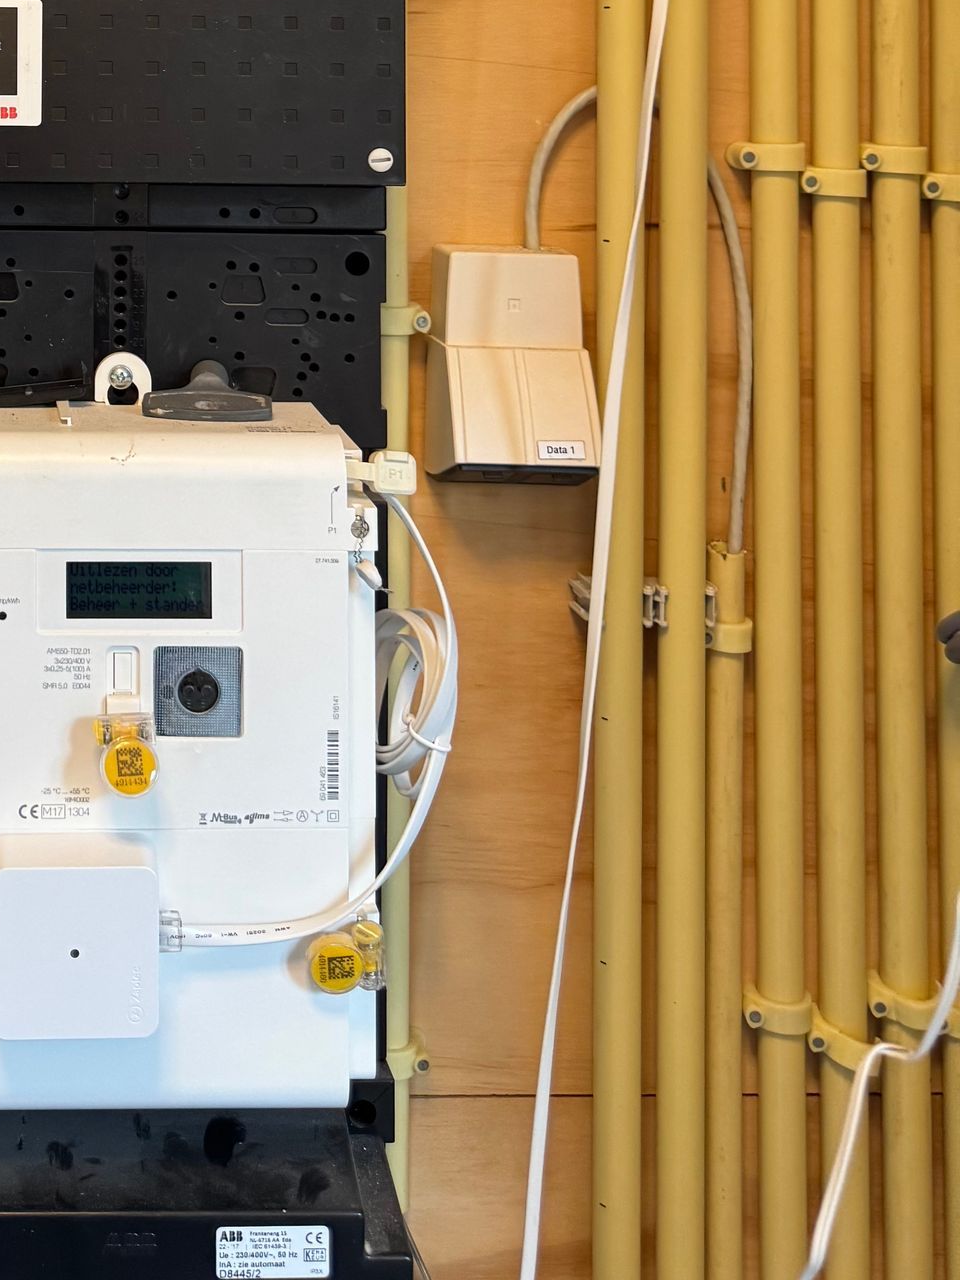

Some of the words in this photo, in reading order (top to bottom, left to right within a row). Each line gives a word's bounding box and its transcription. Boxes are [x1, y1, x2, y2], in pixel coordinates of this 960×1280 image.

[546, 445, 567, 454] Data
[570, 445, 575, 454] 1
[328, 527, 337, 535] P1
[69, 563, 138, 577] Uitlezen
[145, 563, 178, 577] door
[69, 580, 177, 595] netbeheerder:
[69, 597, 120, 611] Beheer
[42, 806, 63, 816] M17
[68, 806, 90, 817] 1304
[219, 1230, 243, 1242] ABB
[219, 1269, 261, 1279] D8445/2
